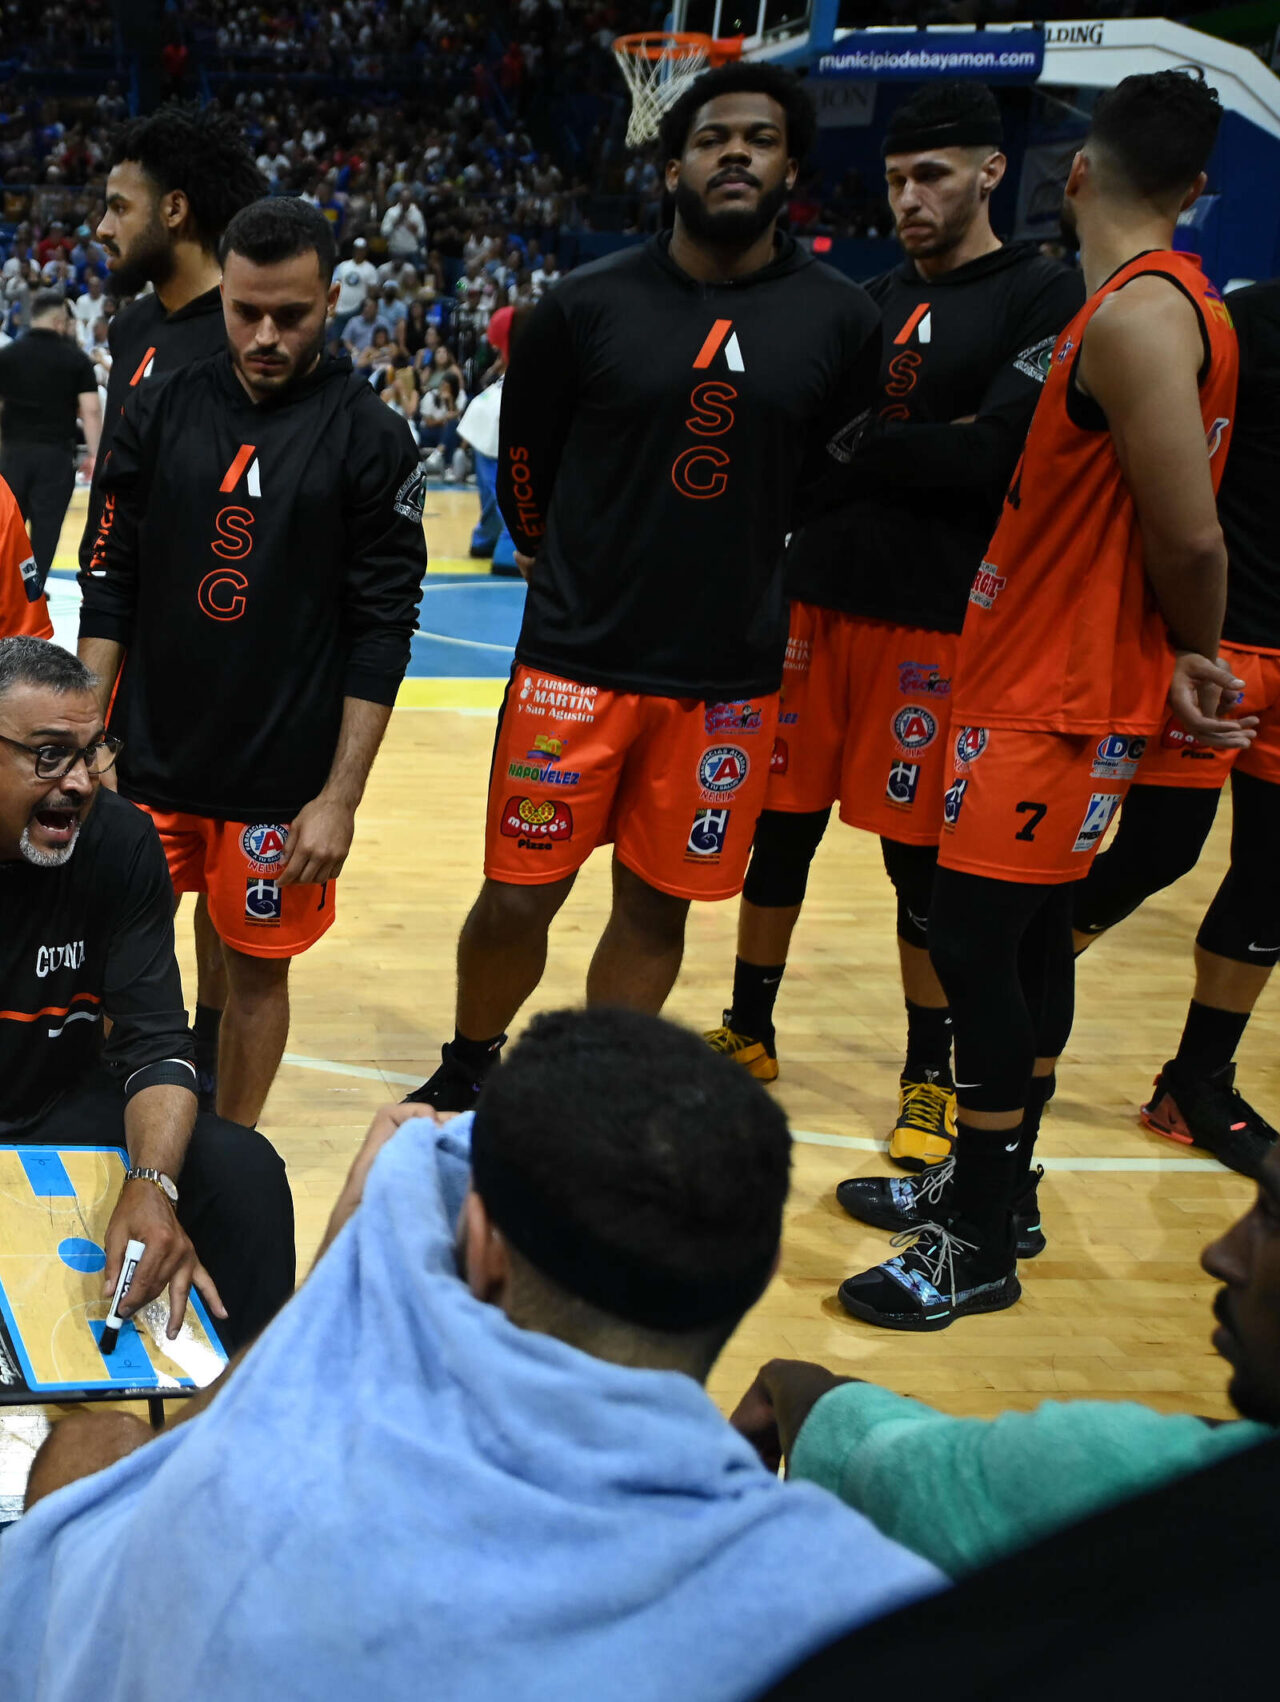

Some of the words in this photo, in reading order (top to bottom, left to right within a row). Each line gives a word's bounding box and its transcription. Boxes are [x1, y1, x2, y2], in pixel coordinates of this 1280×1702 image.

[1047, 22, 1104, 45] LDING
[818, 50, 1035, 73] municipiodebayamon.com
[509, 446, 546, 537] ÉTICOS
[526, 704, 546, 716] San
[1015, 801, 1048, 842] 7
